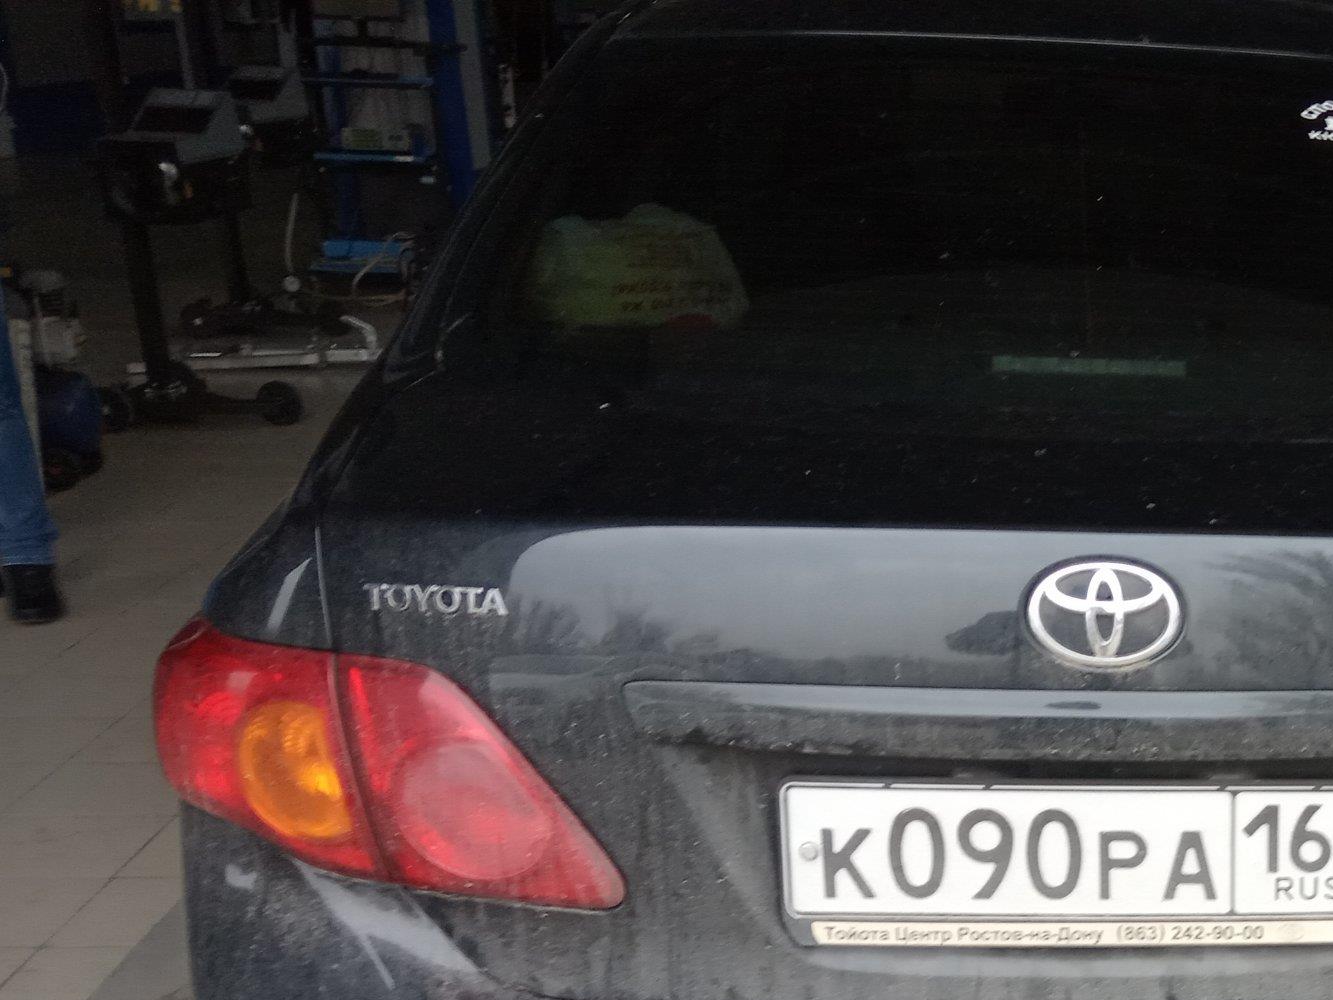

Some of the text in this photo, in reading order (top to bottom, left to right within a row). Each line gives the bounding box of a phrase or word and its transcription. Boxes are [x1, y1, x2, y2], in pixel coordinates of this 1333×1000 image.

[362, 583, 509, 616] TOYOTA
[824, 924, 1265, 945] Тойота Центр Ростов-на-Дону (863) 242-90-00
